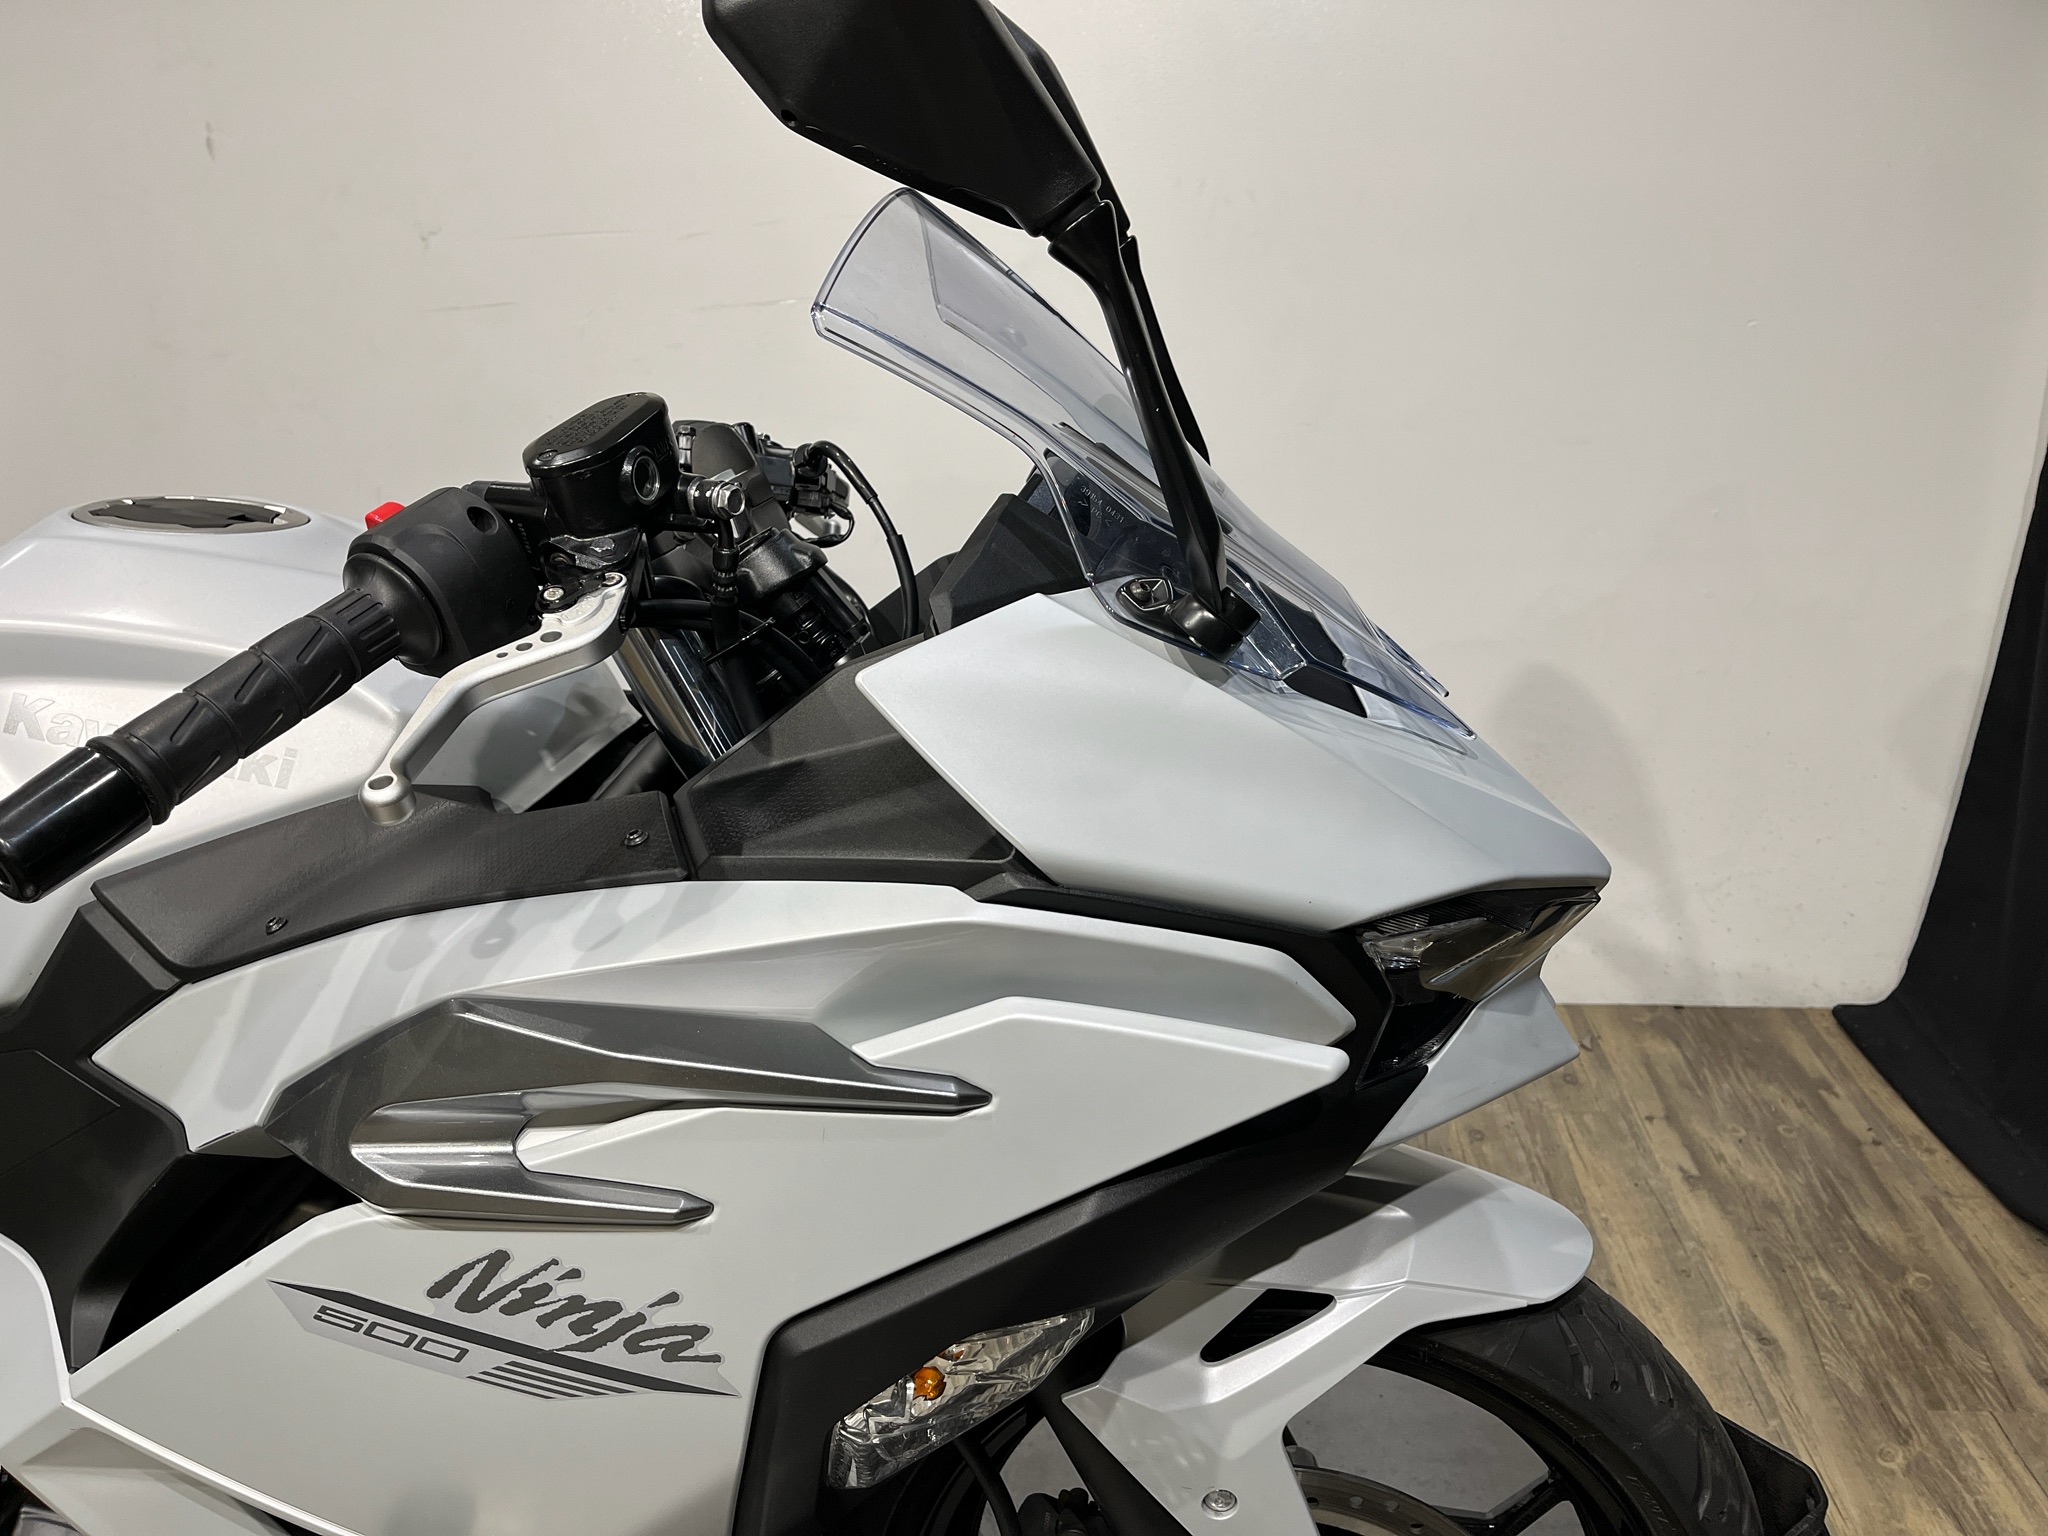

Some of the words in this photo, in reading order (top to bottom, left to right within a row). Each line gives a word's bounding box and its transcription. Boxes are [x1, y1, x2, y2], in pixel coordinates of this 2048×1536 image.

[3, 692, 298, 789] Kaki
[313, 1304, 470, 1363] 500
[426, 1248, 722, 1363] Ninja
